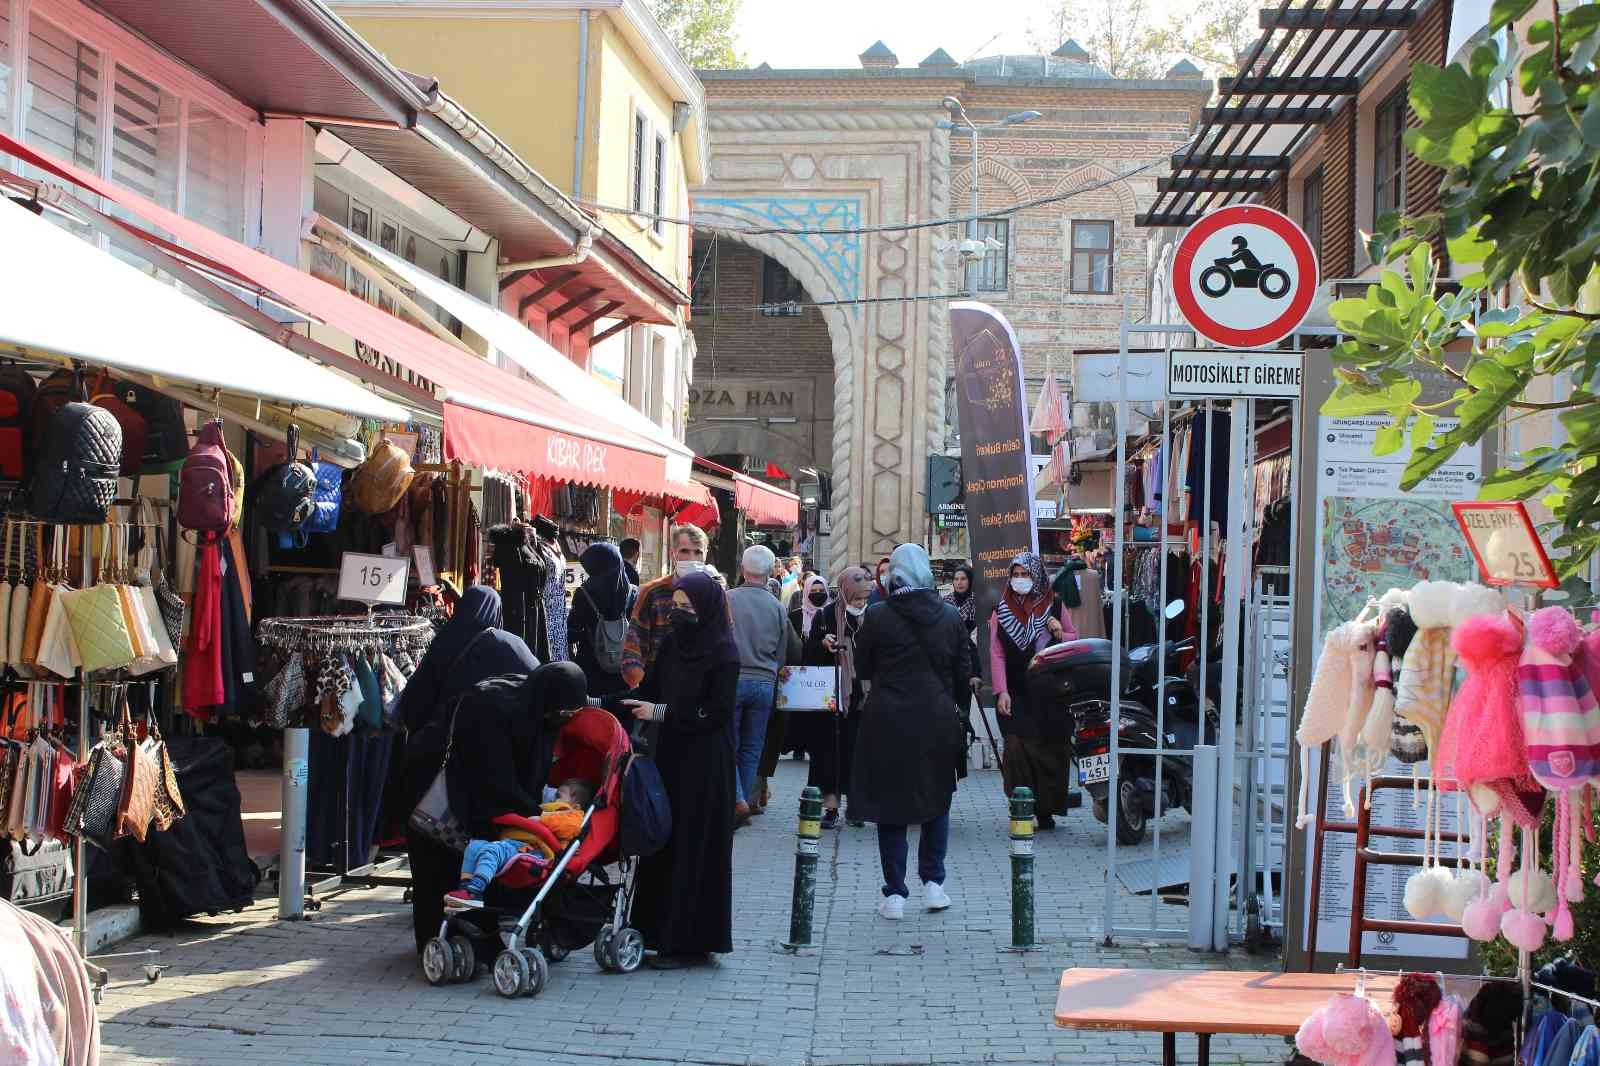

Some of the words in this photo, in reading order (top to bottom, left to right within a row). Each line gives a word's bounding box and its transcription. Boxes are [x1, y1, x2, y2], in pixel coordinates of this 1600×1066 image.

[1173, 362, 1250, 384] MOTOSİKLET
[1254, 363, 1301, 385] GİREME
[688, 389, 735, 406] OZA
[745, 390, 794, 406] HAN
[546, 432, 581, 471] KİBAR
[1508, 552, 1535, 577] 25
[360, 565, 382, 586] 15
[1081, 759, 1091, 768] 16
[1088, 766, 1107, 778] 451
